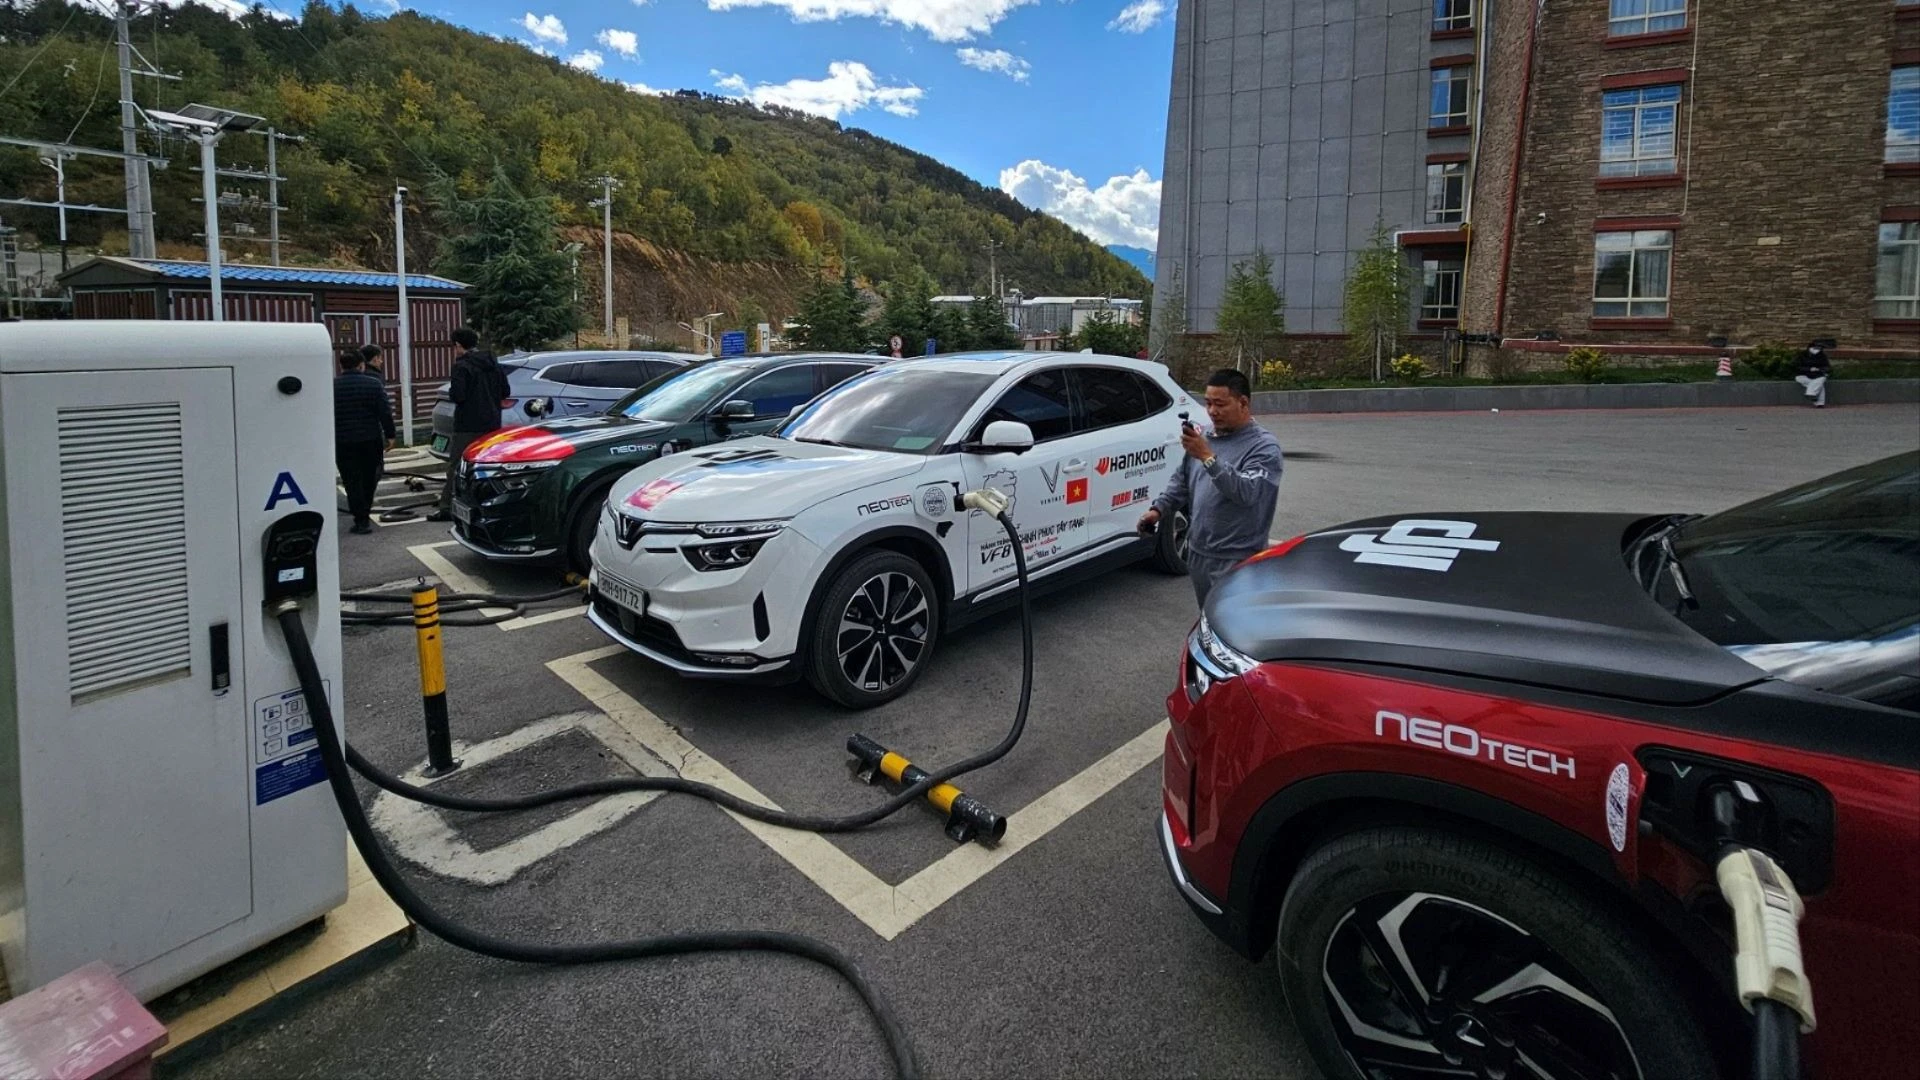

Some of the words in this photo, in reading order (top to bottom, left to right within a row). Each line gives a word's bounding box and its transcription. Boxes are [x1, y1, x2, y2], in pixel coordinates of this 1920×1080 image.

[264, 472, 308, 511] A
[981, 543, 1011, 565] VF8
[1376, 711, 1576, 779] NEOTECH
